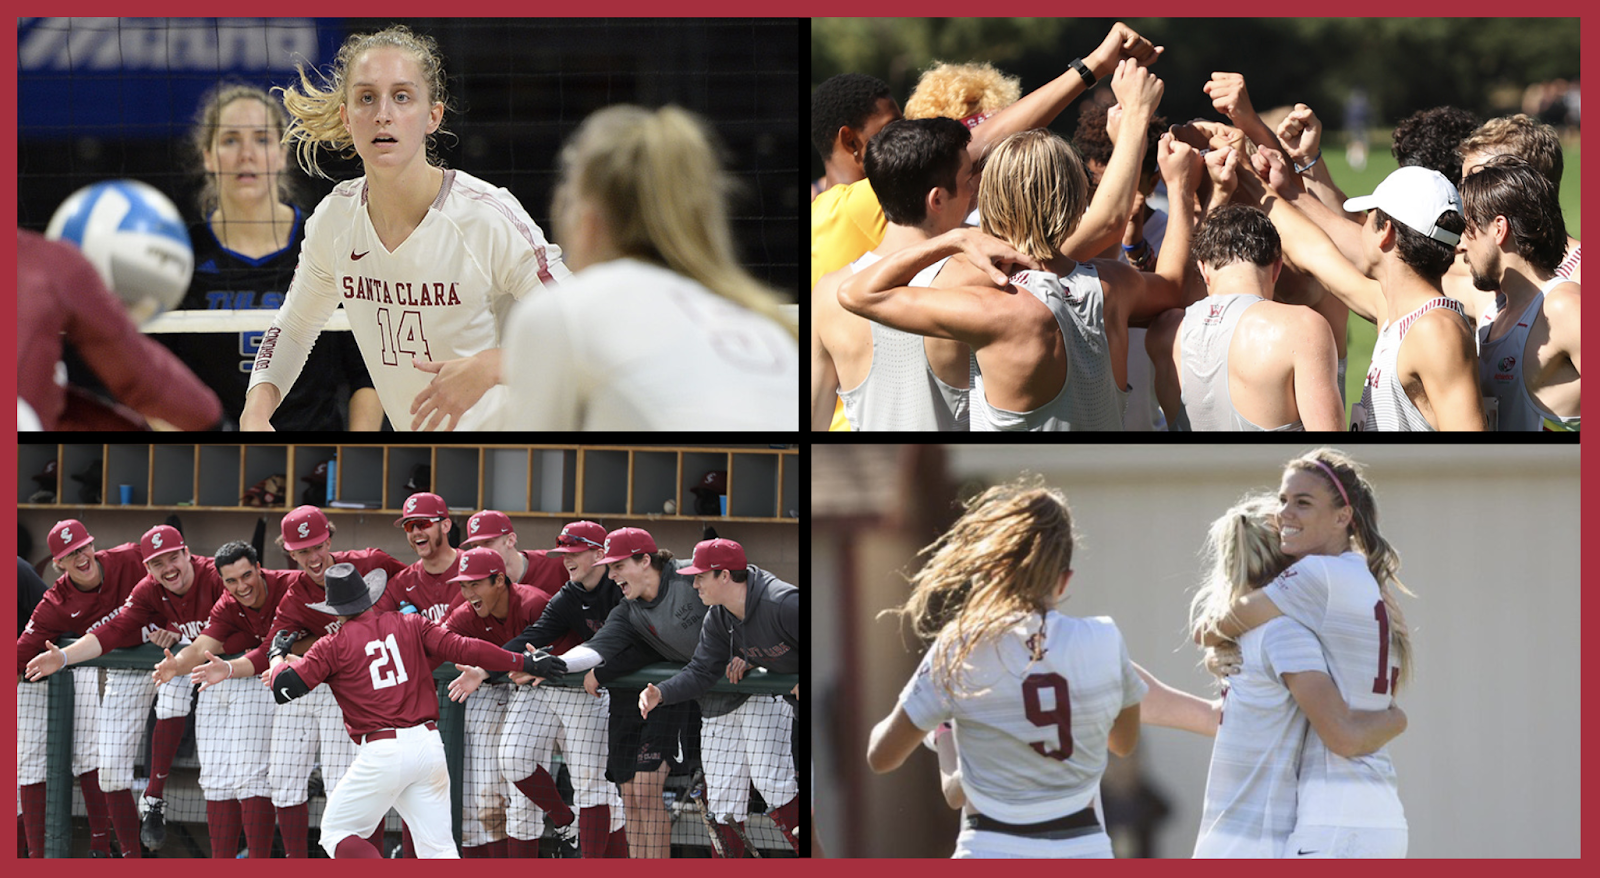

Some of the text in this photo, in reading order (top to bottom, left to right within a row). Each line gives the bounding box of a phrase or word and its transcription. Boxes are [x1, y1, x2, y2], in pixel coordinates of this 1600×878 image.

[205, 290, 286, 311] TULS
[343, 276, 462, 306] SANTA CLARA
[257, 323, 282, 360] BRONCO
[377, 307, 433, 367] 14
[675, 602, 693, 620] NIKE
[364, 633, 408, 690] 21
[1022, 672, 1074, 762] 9
